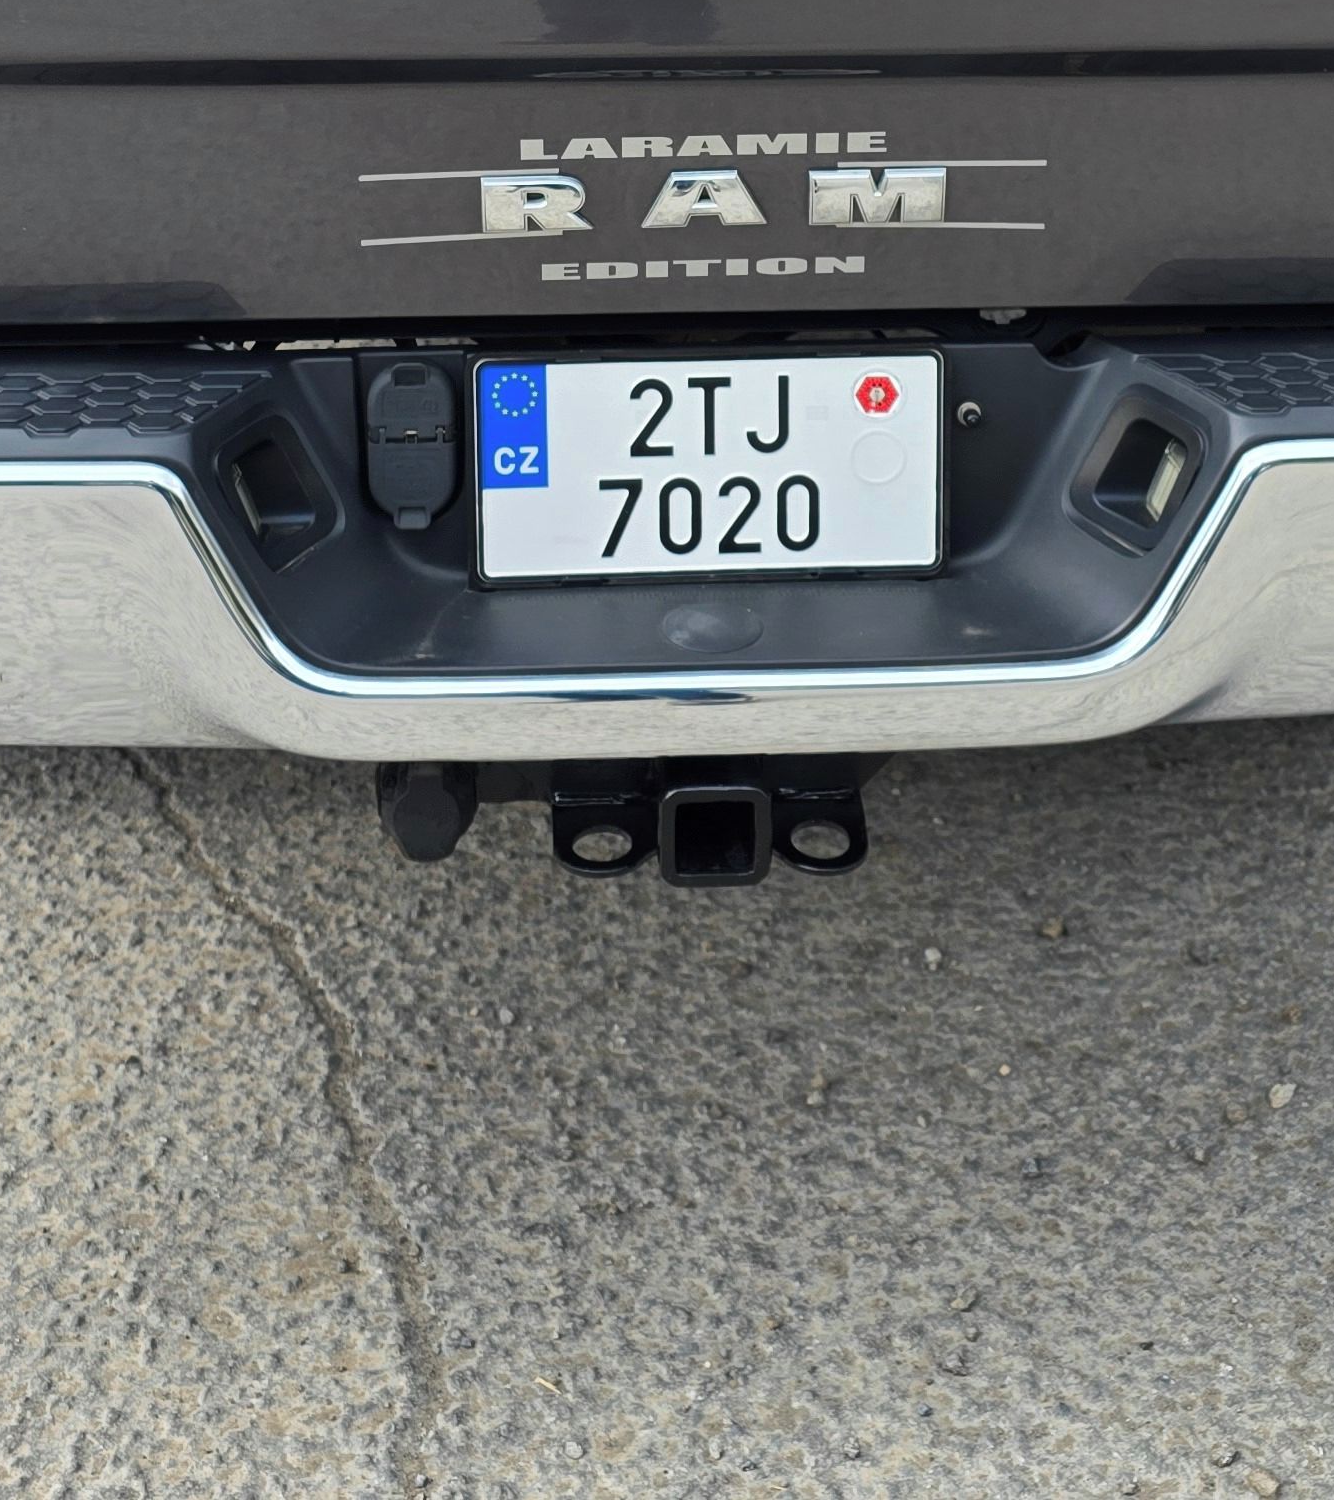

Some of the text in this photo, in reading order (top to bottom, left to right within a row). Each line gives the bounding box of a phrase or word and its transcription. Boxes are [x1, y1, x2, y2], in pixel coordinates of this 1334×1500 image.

[520, 131, 888, 161] LARAMIE
[480, 167, 947, 233] RAM
[541, 256, 866, 281] EDITION
[628, 375, 789, 457] 2TJ
[494, 447, 540, 475] CZ
[599, 474, 820, 558] 7020
